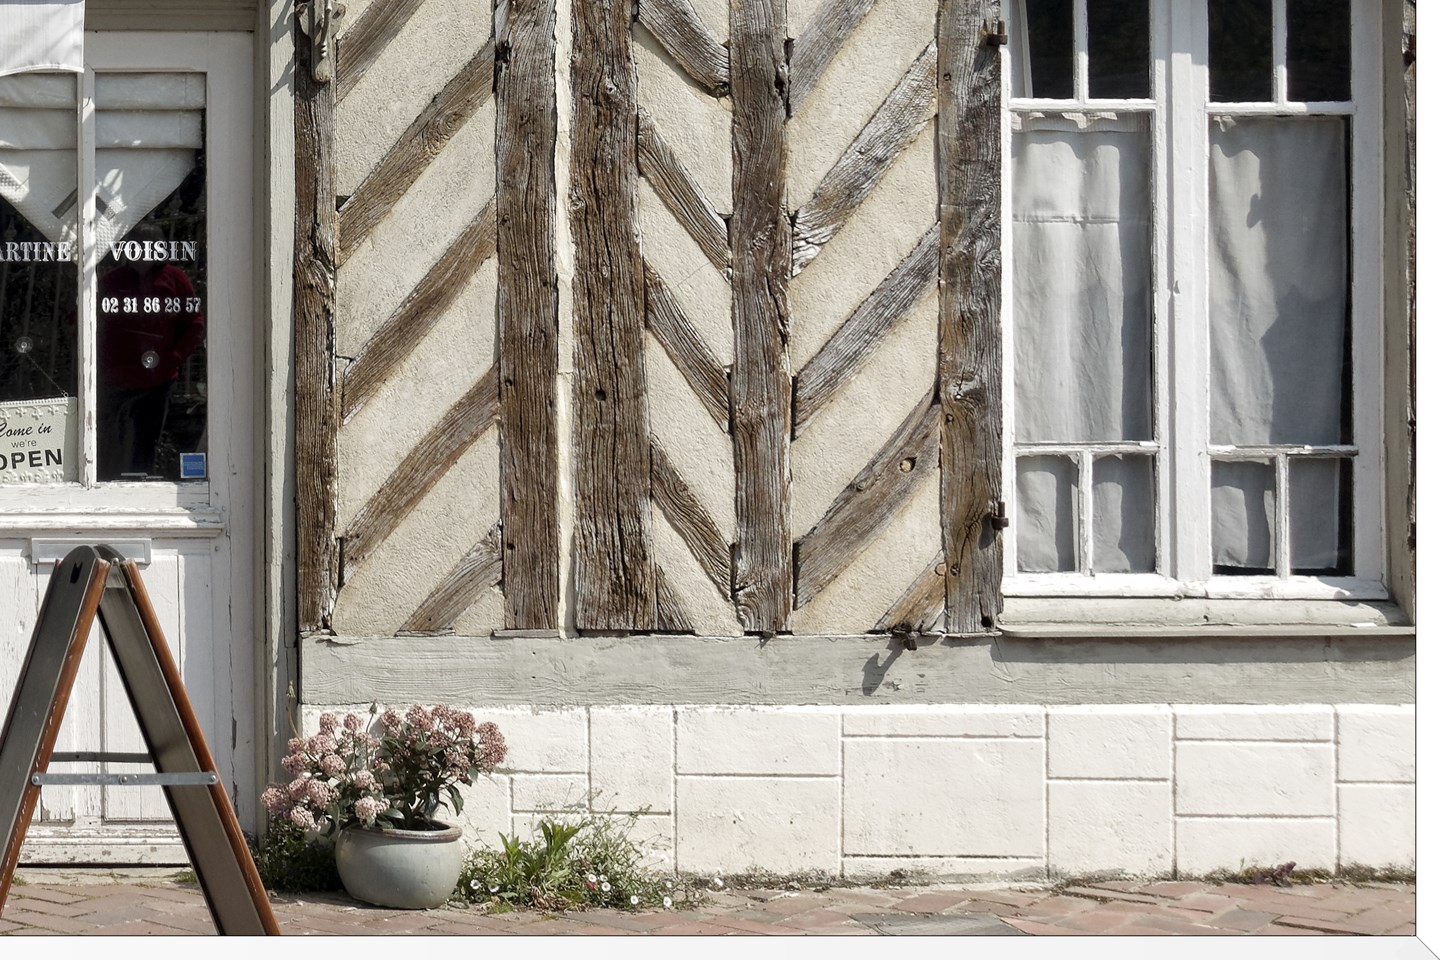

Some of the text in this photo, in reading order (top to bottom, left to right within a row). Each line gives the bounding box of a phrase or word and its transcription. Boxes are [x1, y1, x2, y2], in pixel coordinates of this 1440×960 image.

[110, 240, 198, 262] VOISIN
[101, 297, 201, 313] 02 31 86 28 57
[37, 423, 53, 436] in
[11, 439, 37, 449] we're
